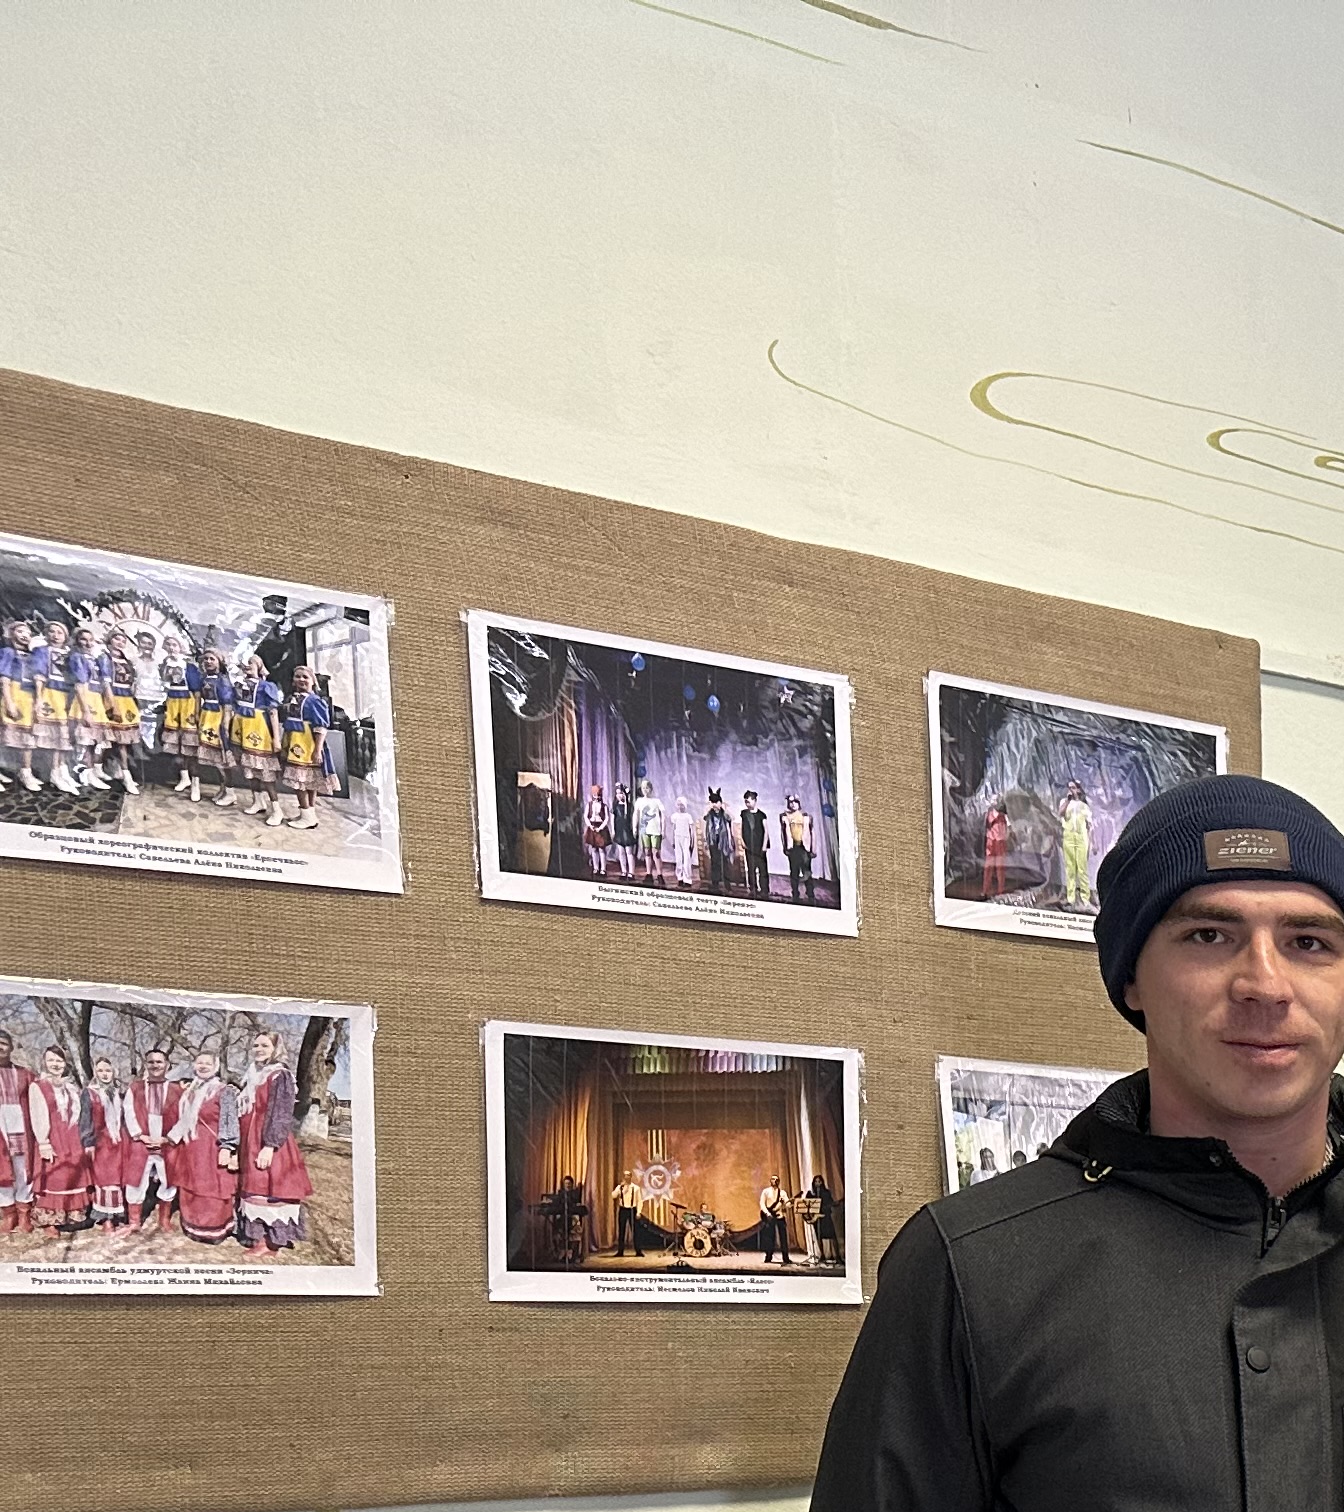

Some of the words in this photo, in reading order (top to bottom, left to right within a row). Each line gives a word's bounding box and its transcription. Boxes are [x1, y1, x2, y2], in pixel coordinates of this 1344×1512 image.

[29, 830, 95, 844] Образцовый
[98, 839, 194, 854] хореографический
[197, 849, 248, 860] коллектив
[60, 845, 136, 859] Руководитель:
[139, 852, 191, 865] Савельева
[194, 858, 222, 868] Алёна
[225, 862, 283, 874] Николаевна
[591, 894, 650, 907] Руководитель:
[696, 897, 719, 906] театр
[16, 1265, 76, 1274] Вокальный
[79, 1266, 127, 1274] ансамбль
[130, 1268, 191, 1276] удмуртской
[31, 1277, 107, 1286] Руководитель:
[110, 1277, 164, 1287] Ермолаева
[167, 1277, 201, 1285] Жанна
[203, 1278, 263, 1286] Михайловна
[709, 1276, 745, 1284] ансамбль
[596, 1285, 655, 1293] Руководитель:
[697, 1285, 730, 1293] Николай
